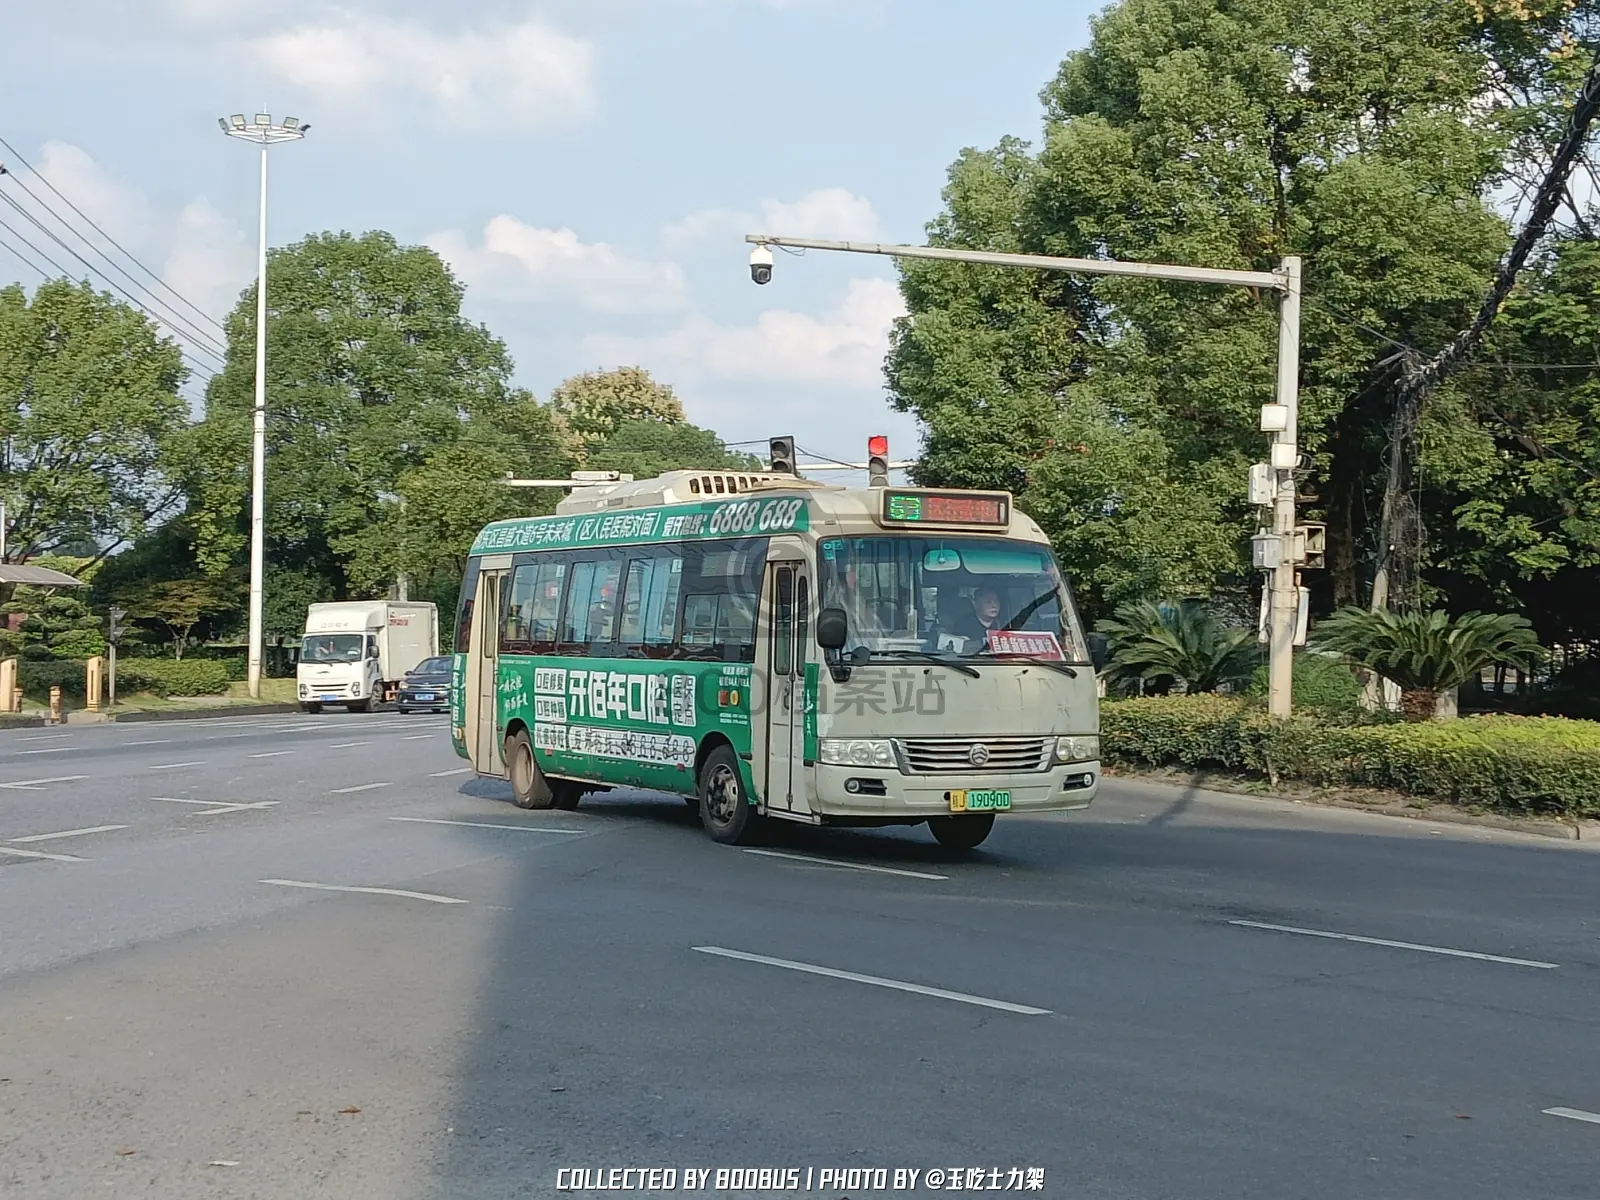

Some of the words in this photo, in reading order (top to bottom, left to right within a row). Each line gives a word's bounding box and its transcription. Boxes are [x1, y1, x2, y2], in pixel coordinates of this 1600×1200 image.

[709, 500, 760, 534] 6888
[759, 498, 803, 531] 688
[569, 670, 669, 725] 牙佰年口腔
